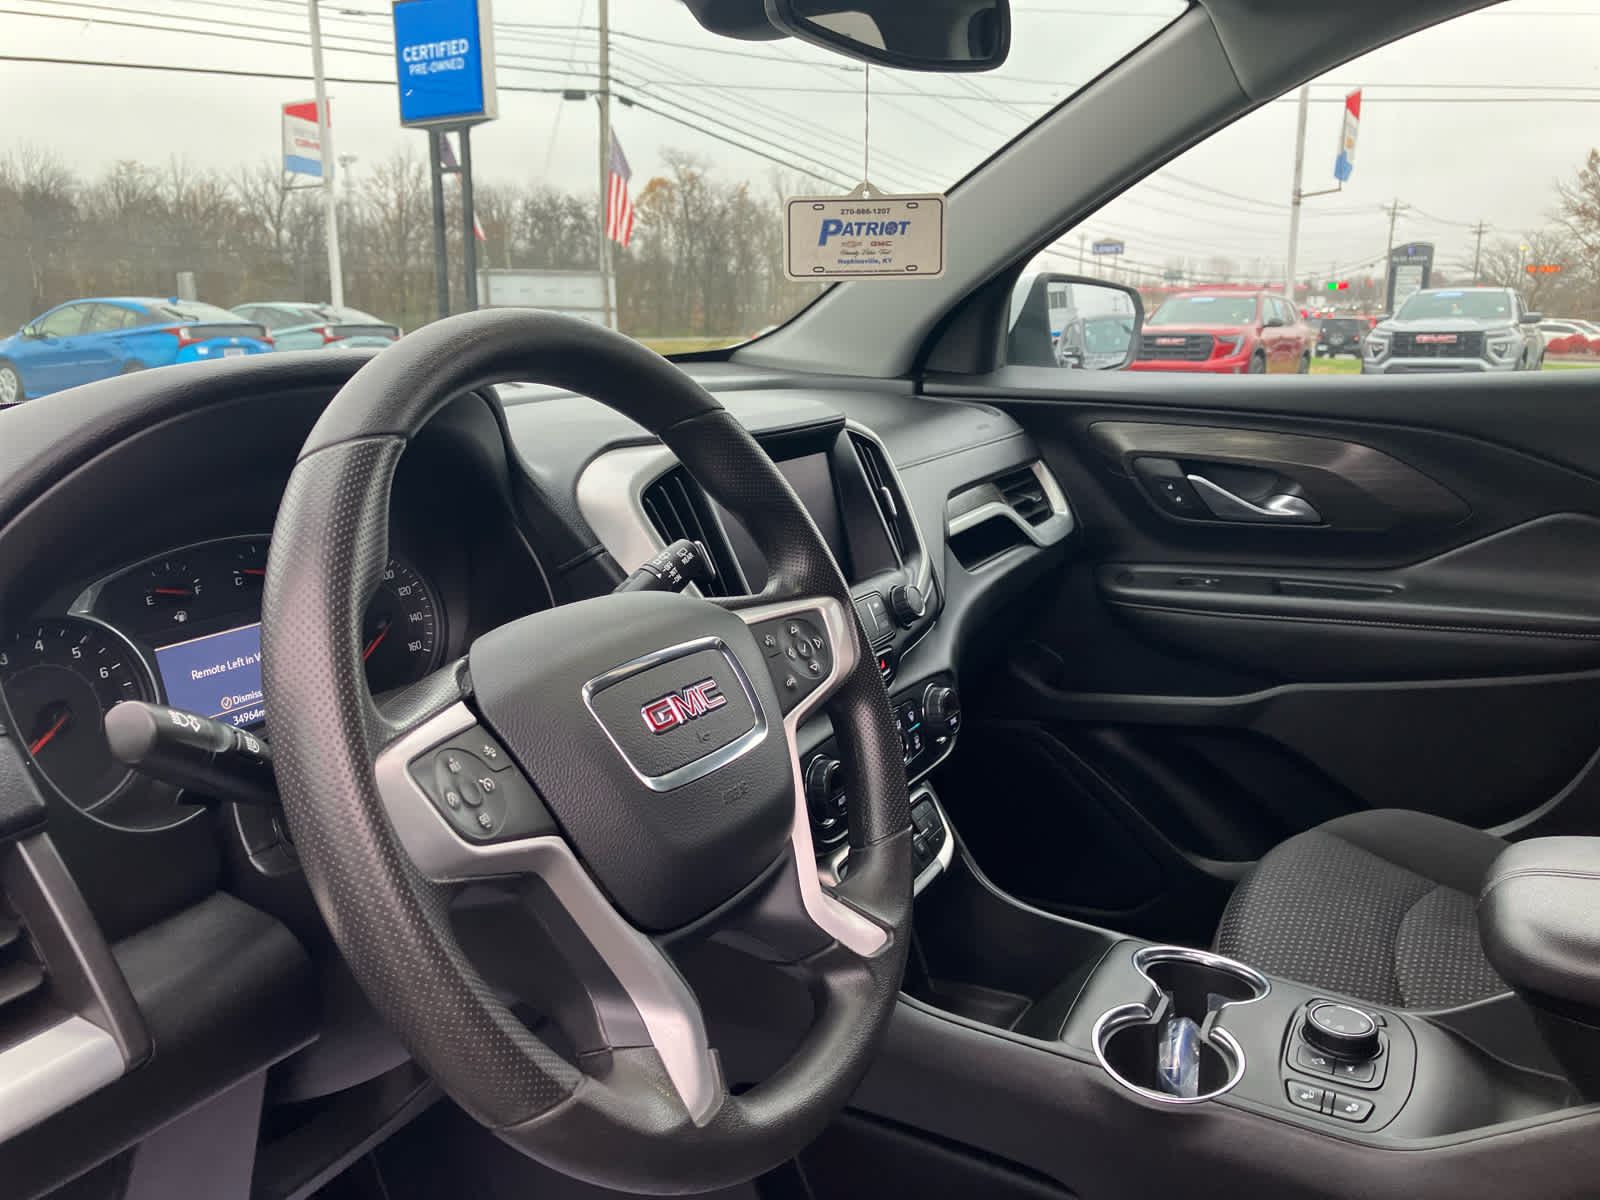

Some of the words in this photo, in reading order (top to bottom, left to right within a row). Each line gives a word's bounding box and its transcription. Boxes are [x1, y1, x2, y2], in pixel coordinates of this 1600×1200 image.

[403, 38, 469, 62] CERTIFIED
[408, 57, 465, 75] PRE-OWNED
[818, 218, 911, 247] PATRIOT
[383, 569, 395, 580] 00
[235, 577, 243, 586] C
[194, 585, 202, 596] F
[398, 585, 412, 597] 120
[146, 596, 155, 606] E
[409, 611, 423, 623] 140
[34, 640, 44, 651] 4
[408, 641, 422, 652] 160
[71, 647, 81, 660] 5
[99, 667, 109, 680] 6
[191, 664, 226, 680] Remote
[226, 657, 245, 670] Left
[232, 690, 263, 704] Dismiss
[640, 679, 727, 733] GMC
[232, 709, 265, 725] 34964m
